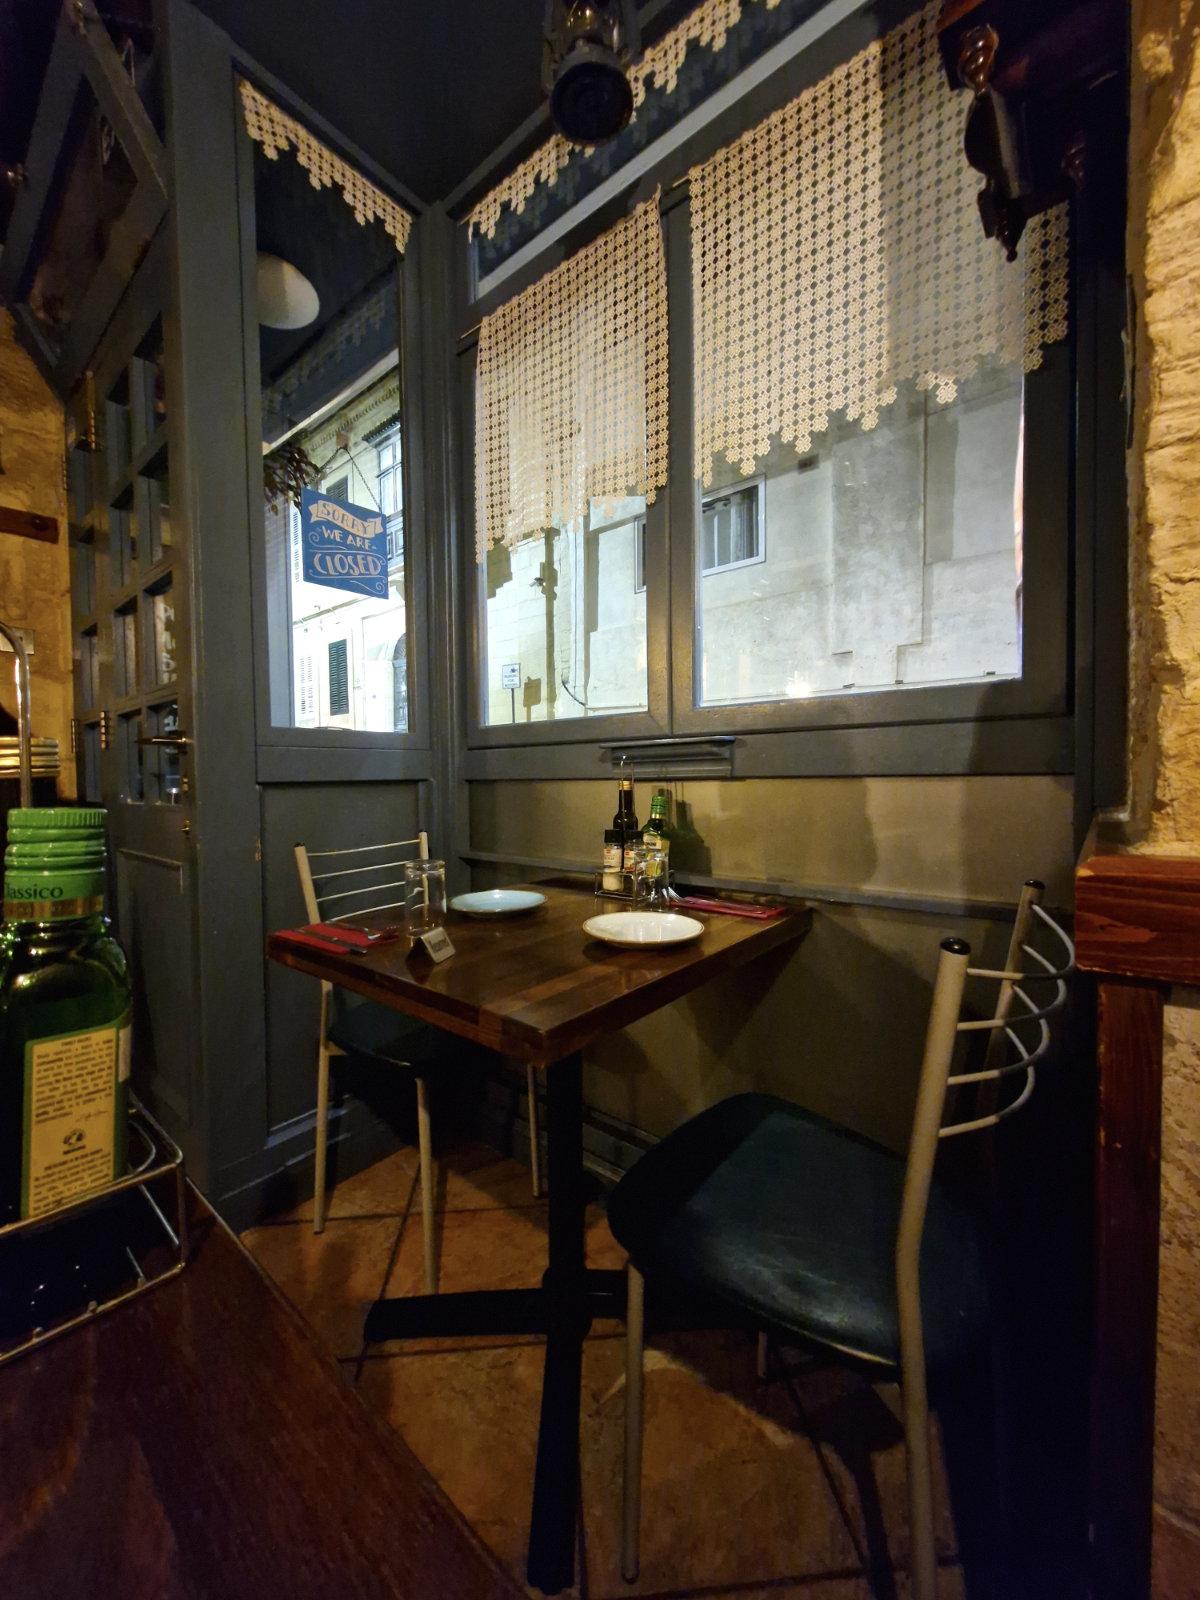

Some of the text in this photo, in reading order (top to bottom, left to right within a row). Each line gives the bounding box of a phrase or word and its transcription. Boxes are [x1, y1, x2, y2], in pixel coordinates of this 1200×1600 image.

[321, 502, 370, 536] SORRY
[322, 525, 371, 550] WE ARE
[313, 553, 381, 576] CLOSED
